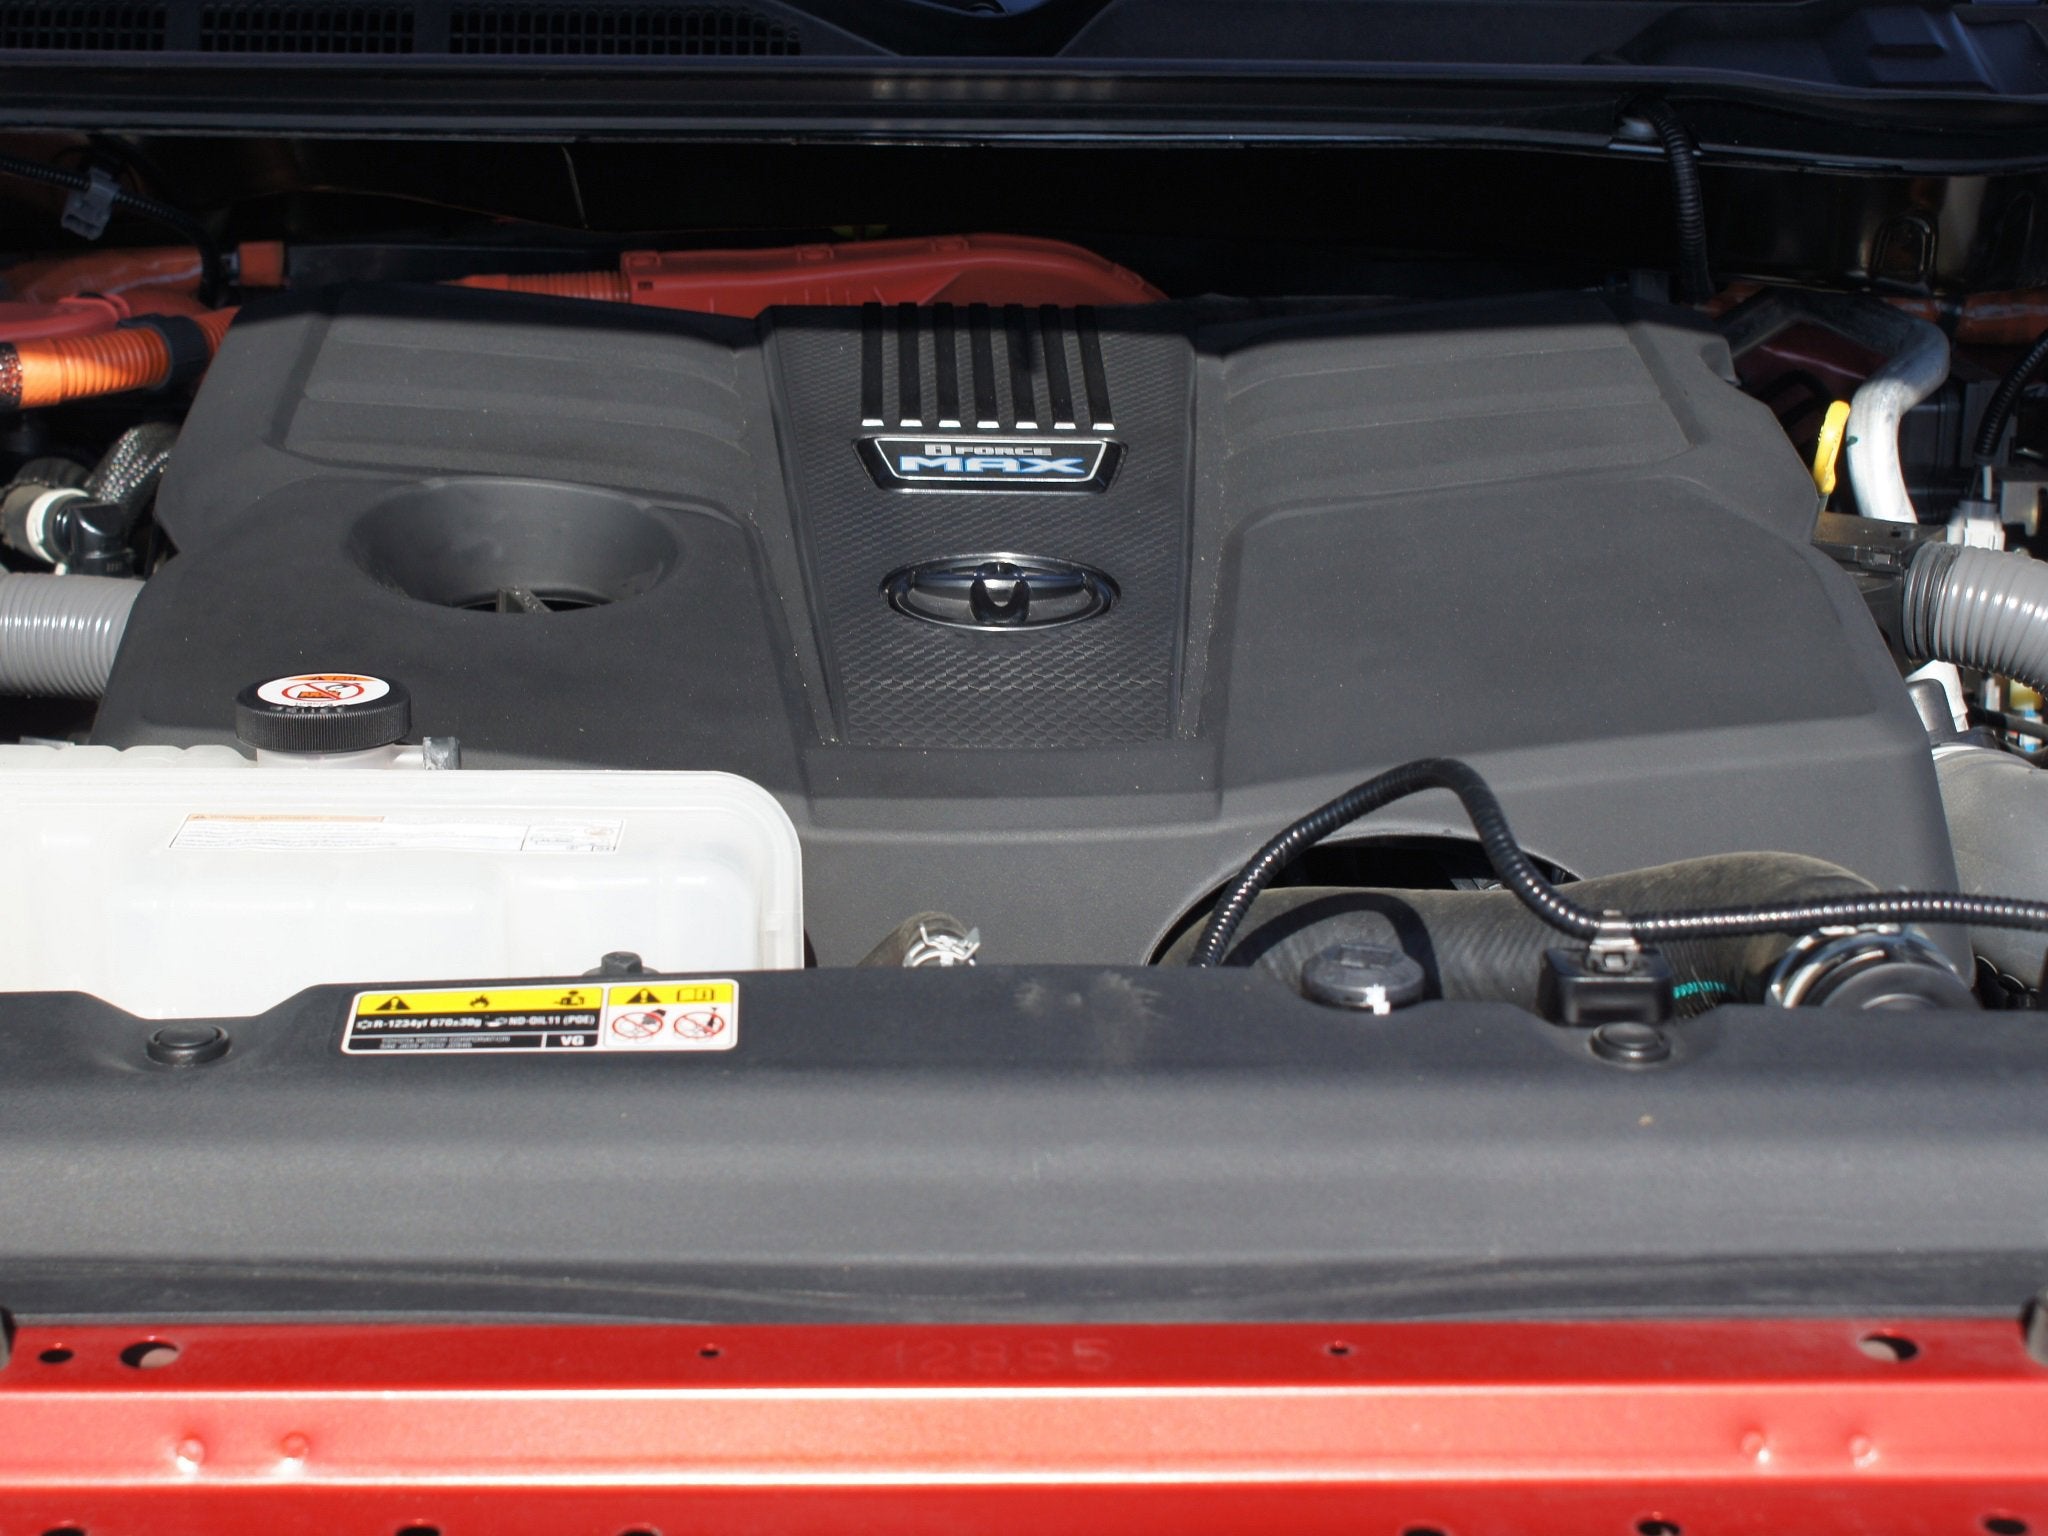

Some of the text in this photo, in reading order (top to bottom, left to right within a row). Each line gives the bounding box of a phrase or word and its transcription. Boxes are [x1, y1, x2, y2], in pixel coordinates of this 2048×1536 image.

[955, 446, 1052, 456] FORCE
[899, 456, 1086, 474] MAX
[374, 1018, 428, 1029] R-1234yf
[560, 1035, 585, 1046] VG
